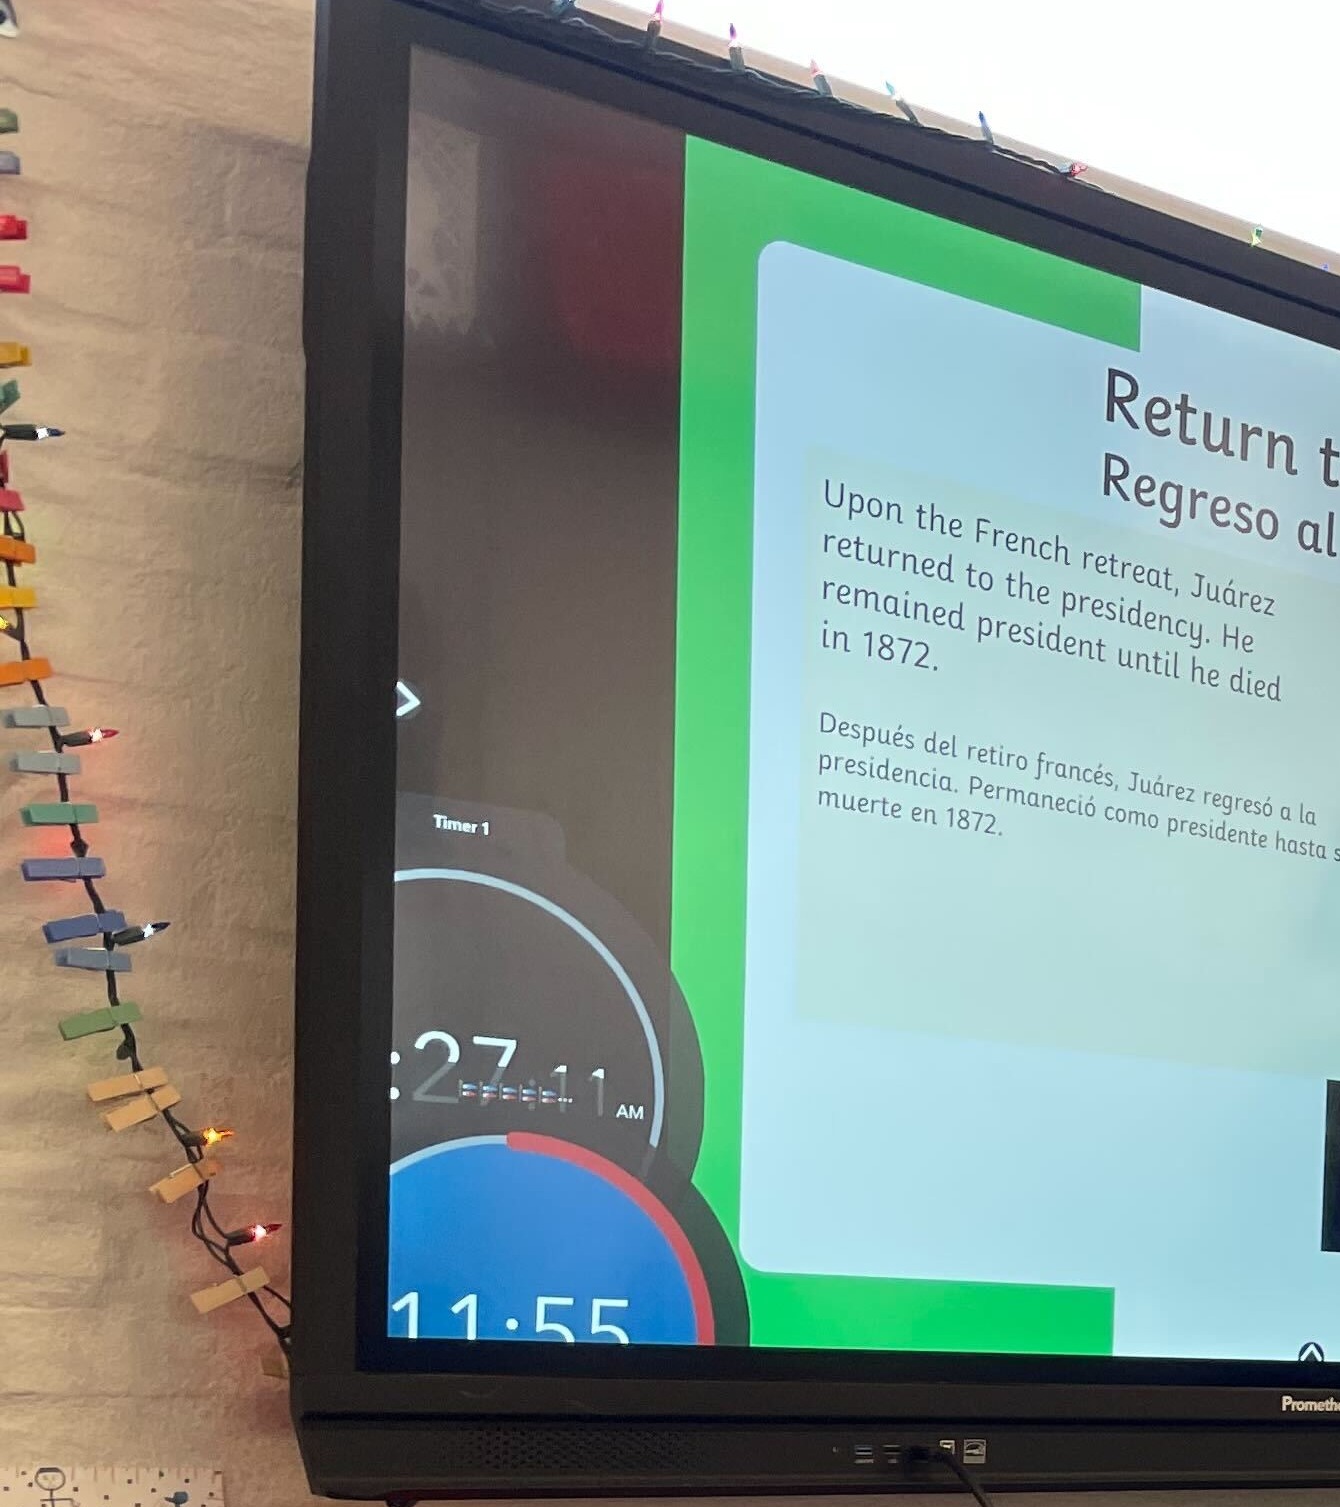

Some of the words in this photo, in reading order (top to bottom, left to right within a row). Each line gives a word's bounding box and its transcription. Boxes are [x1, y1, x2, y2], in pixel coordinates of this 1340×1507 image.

[1105, 367, 1298, 475] Return
[824, 478, 904, 525] Upon
[915, 502, 963, 539] the
[975, 517, 1072, 566] French
[1080, 551, 1179, 598] retreat,
[1190, 572, 1275, 617] Juárez
[1103, 452, 1279, 541] Regreso
[1297, 511, 1337, 558] al
[822, 580, 966, 631] remained
[977, 614, 1107, 663] president
[1118, 647, 1181, 679] until
[1191, 655, 1220, 688] he
[1229, 666, 1282, 702] died
[822, 619, 851, 653] in
[863, 630, 938, 672] 1872.
[823, 533, 955, 584] returned
[965, 562, 994, 592] to
[1005, 570, 1050, 605] the
[1061, 589, 1211, 650] presidency.
[1222, 622, 1254, 654] He
[818, 753, 959, 794] presidencia.
[969, 775, 1097, 818] Permaneció
[1103, 805, 1159, 829] como
[1167, 814, 1269, 849] presidente
[1275, 830, 1328, 860] hasta
[818, 790, 903, 819] muerte
[911, 806, 938, 826] en
[946, 806, 1003, 837] 1872.
[819, 711, 915, 751] Después
[923, 730, 958, 759] del
[967, 744, 1029, 771] retiro
[1033, 751, 1119, 792] francés,
[1127, 771, 1196, 803] Juárez
[1203, 789, 1273, 817] regresó
[1279, 806, 1292, 822] a
[1299, 802, 1317, 827] la
[433, 814, 478, 834] Timer
[481, 821, 490, 836] 1
[615, 1103, 645, 1120] AM
